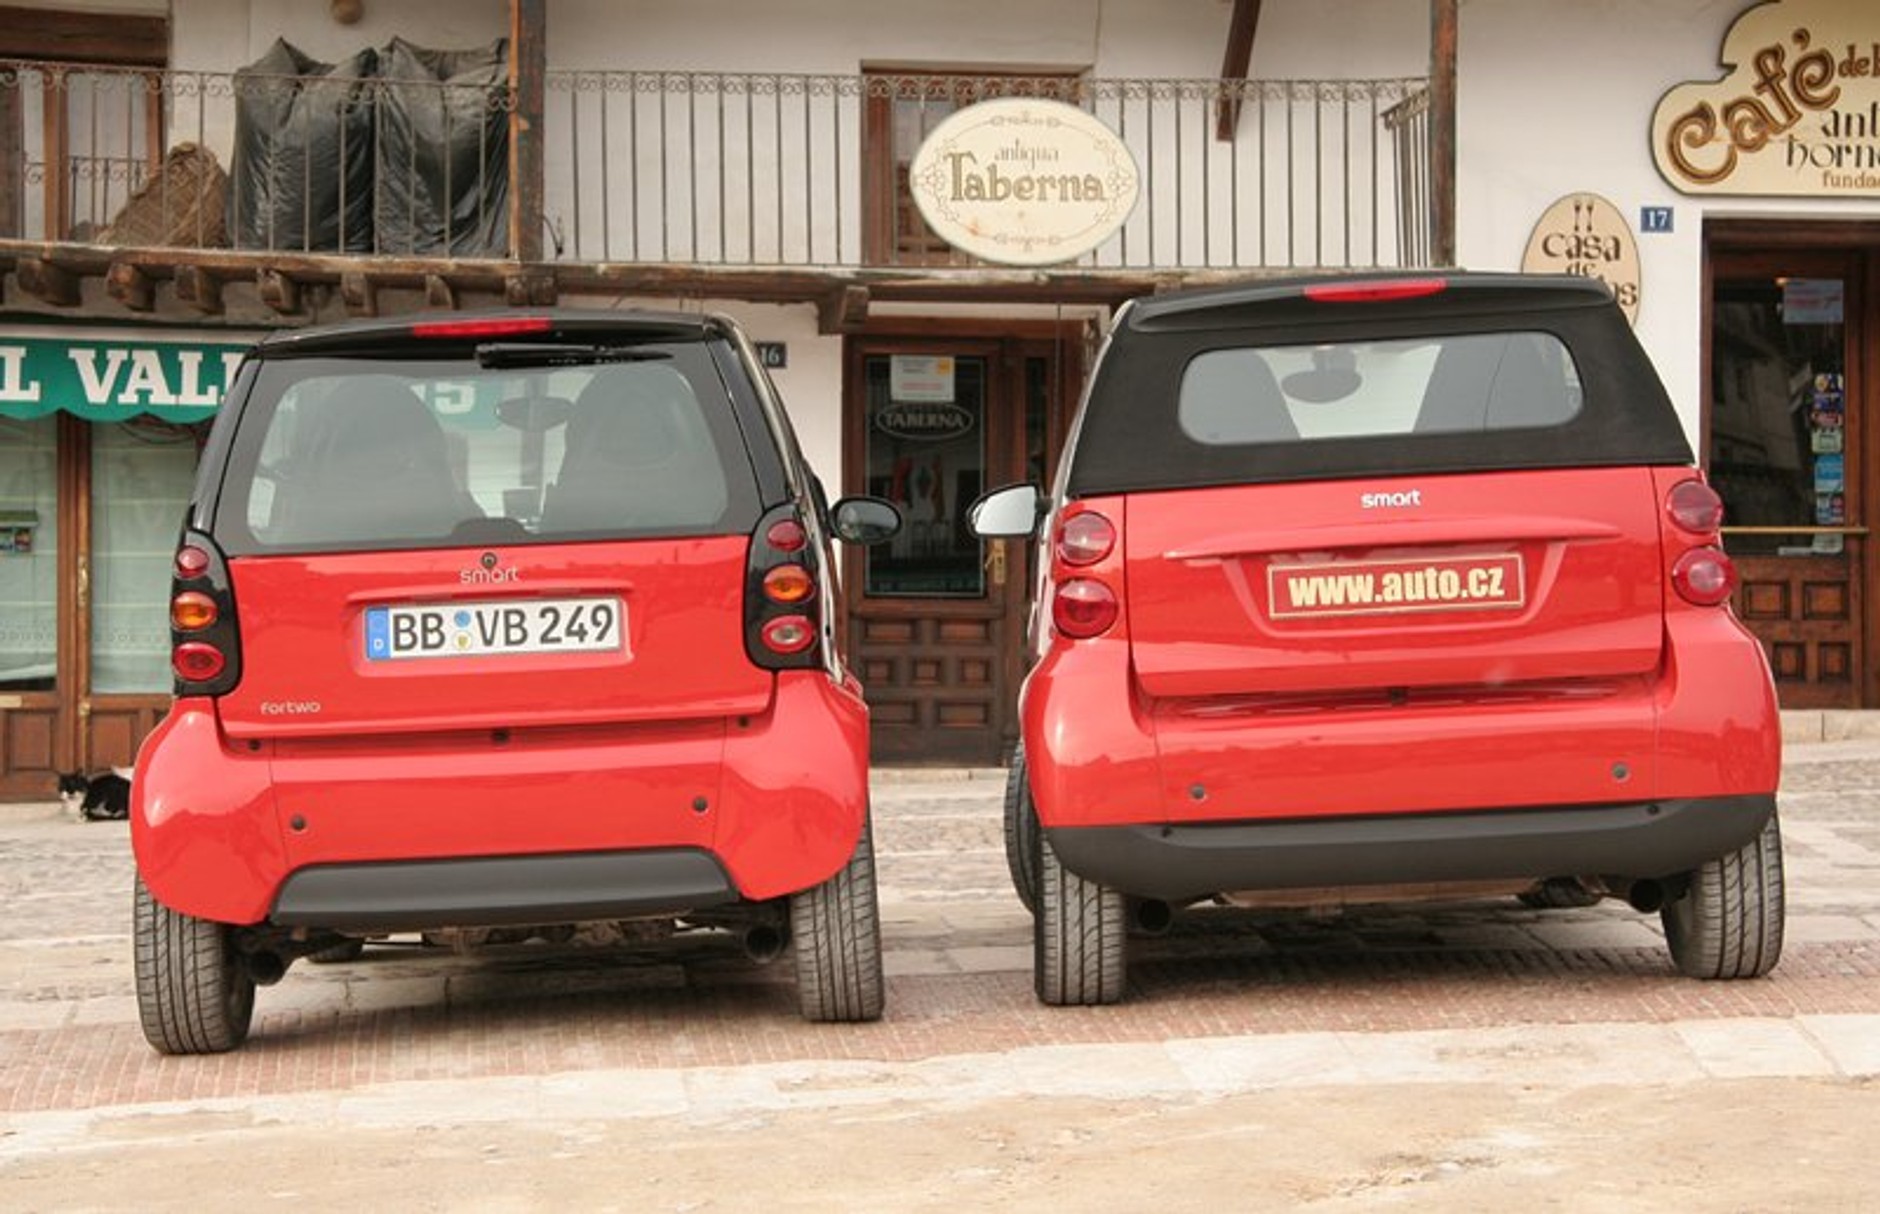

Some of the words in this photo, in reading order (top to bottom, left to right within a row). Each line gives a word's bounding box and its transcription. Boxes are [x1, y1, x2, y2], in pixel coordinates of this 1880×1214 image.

[1786, 133, 1880, 173] horn
[943, 150, 1107, 201] Taberna
[1649, 210, 1668, 228] 17
[761, 345, 780, 366] 16
[1361, 489, 1421, 509] smart
[460, 566, 519, 585] smart
[1287, 565, 1505, 608] www.auto.cz
[392, 611, 446, 652] BB
[475, 607, 529, 647] VB
[538, 604, 614, 645] 249
